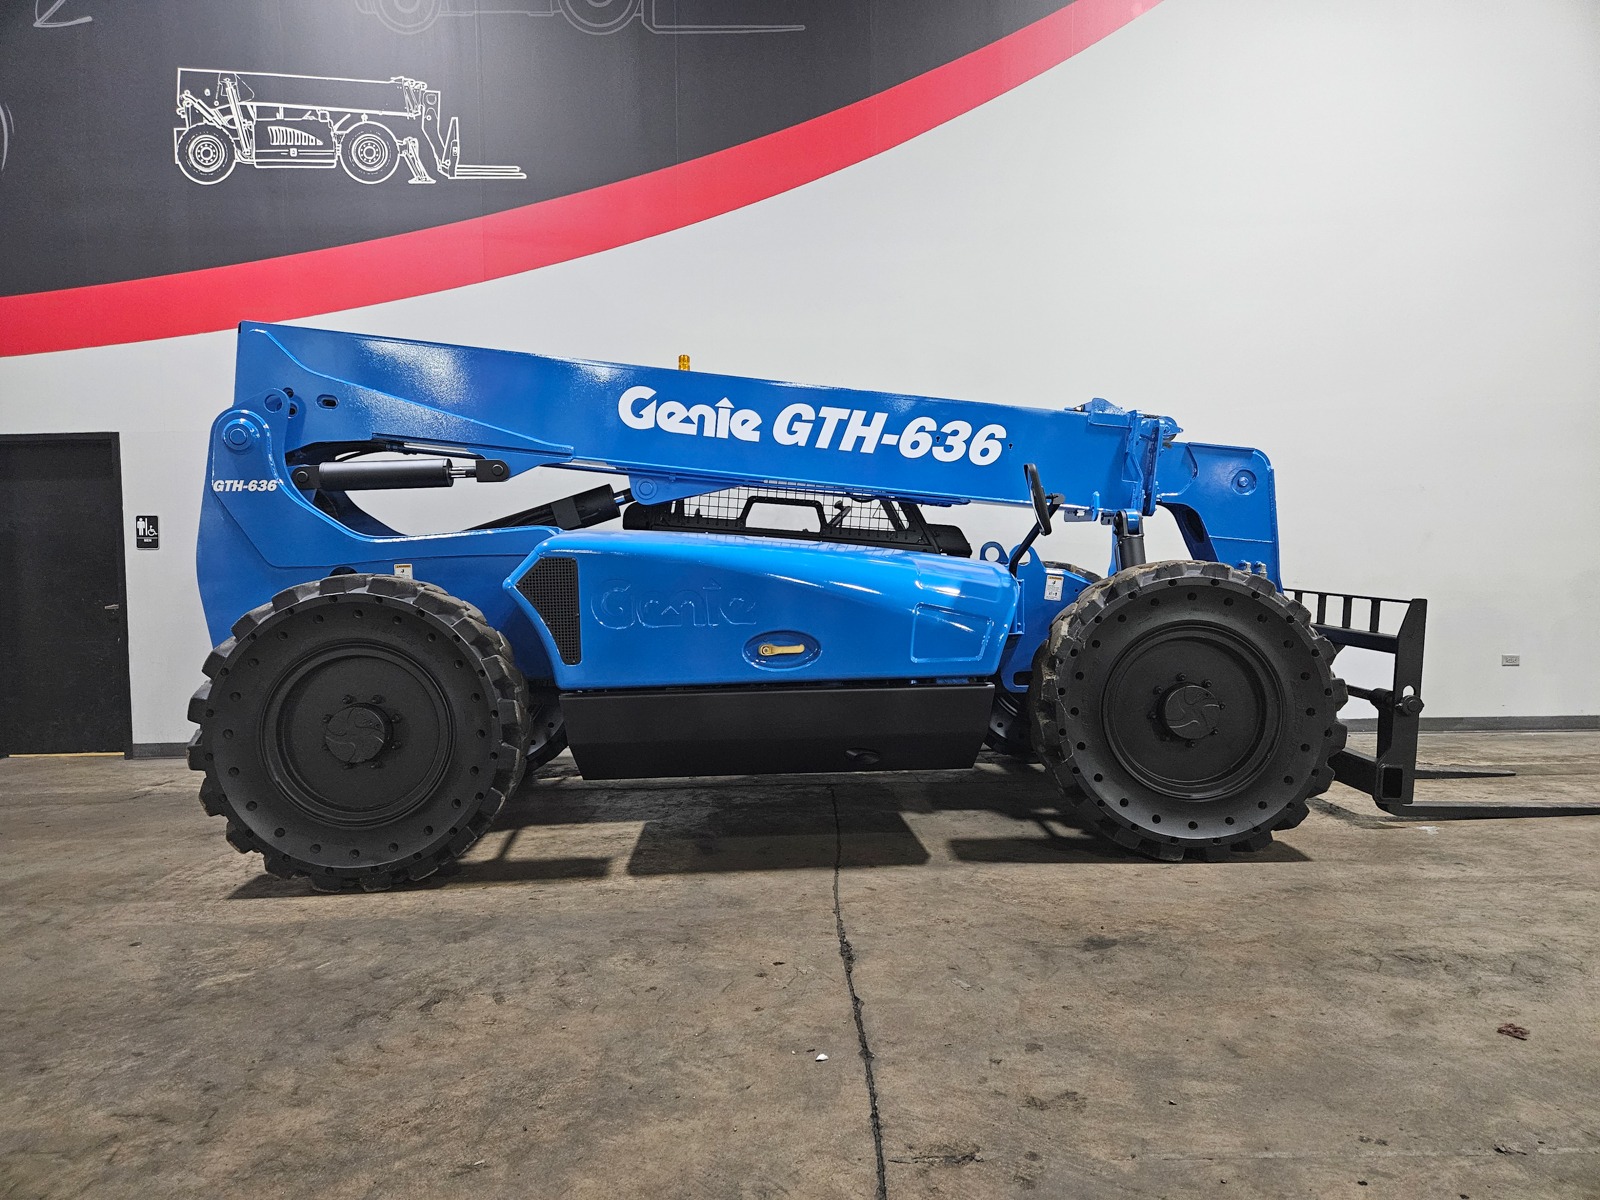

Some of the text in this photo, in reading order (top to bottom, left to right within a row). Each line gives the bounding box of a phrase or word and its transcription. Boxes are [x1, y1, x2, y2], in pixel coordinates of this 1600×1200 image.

[618, 385, 1007, 466] Genie GTH-636
[212, 479, 278, 492] GTH-636
[590, 578, 758, 630] Genie
